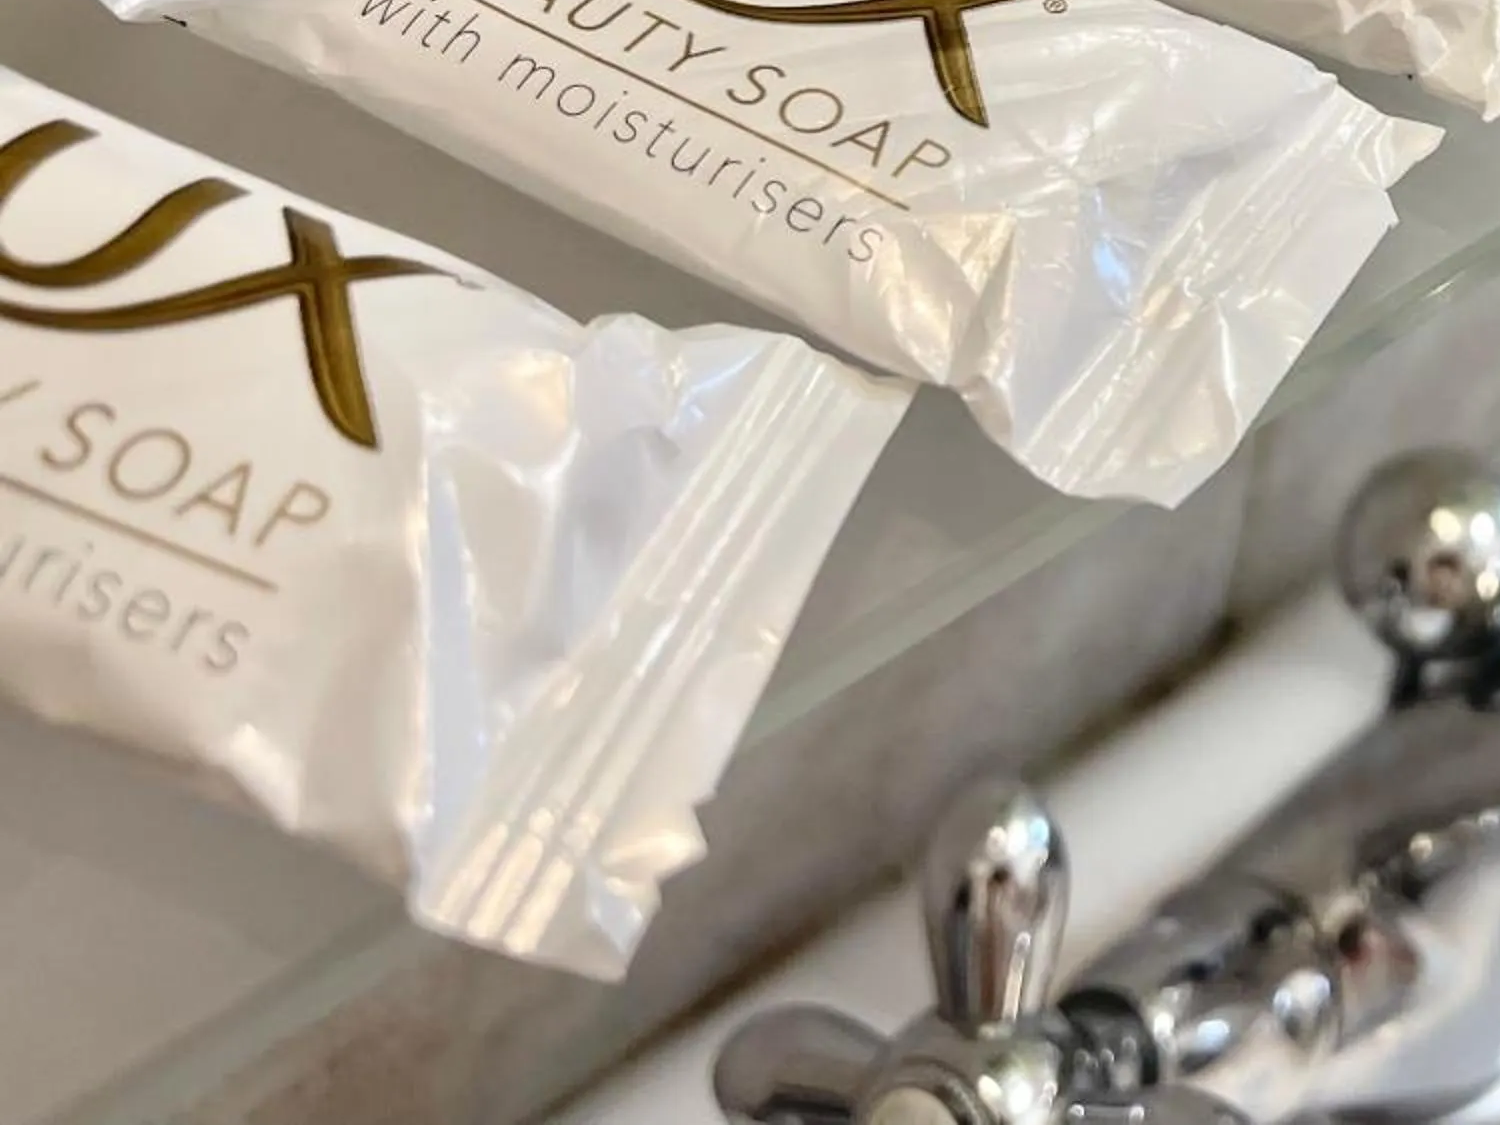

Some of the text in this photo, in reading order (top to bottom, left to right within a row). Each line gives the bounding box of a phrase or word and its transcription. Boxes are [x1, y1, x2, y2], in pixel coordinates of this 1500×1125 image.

[497, 52, 886, 264] moisturisers
[725, 64, 952, 178] SOAP
[0, 119, 470, 452] UX
[38, 401, 332, 548] SOAP
